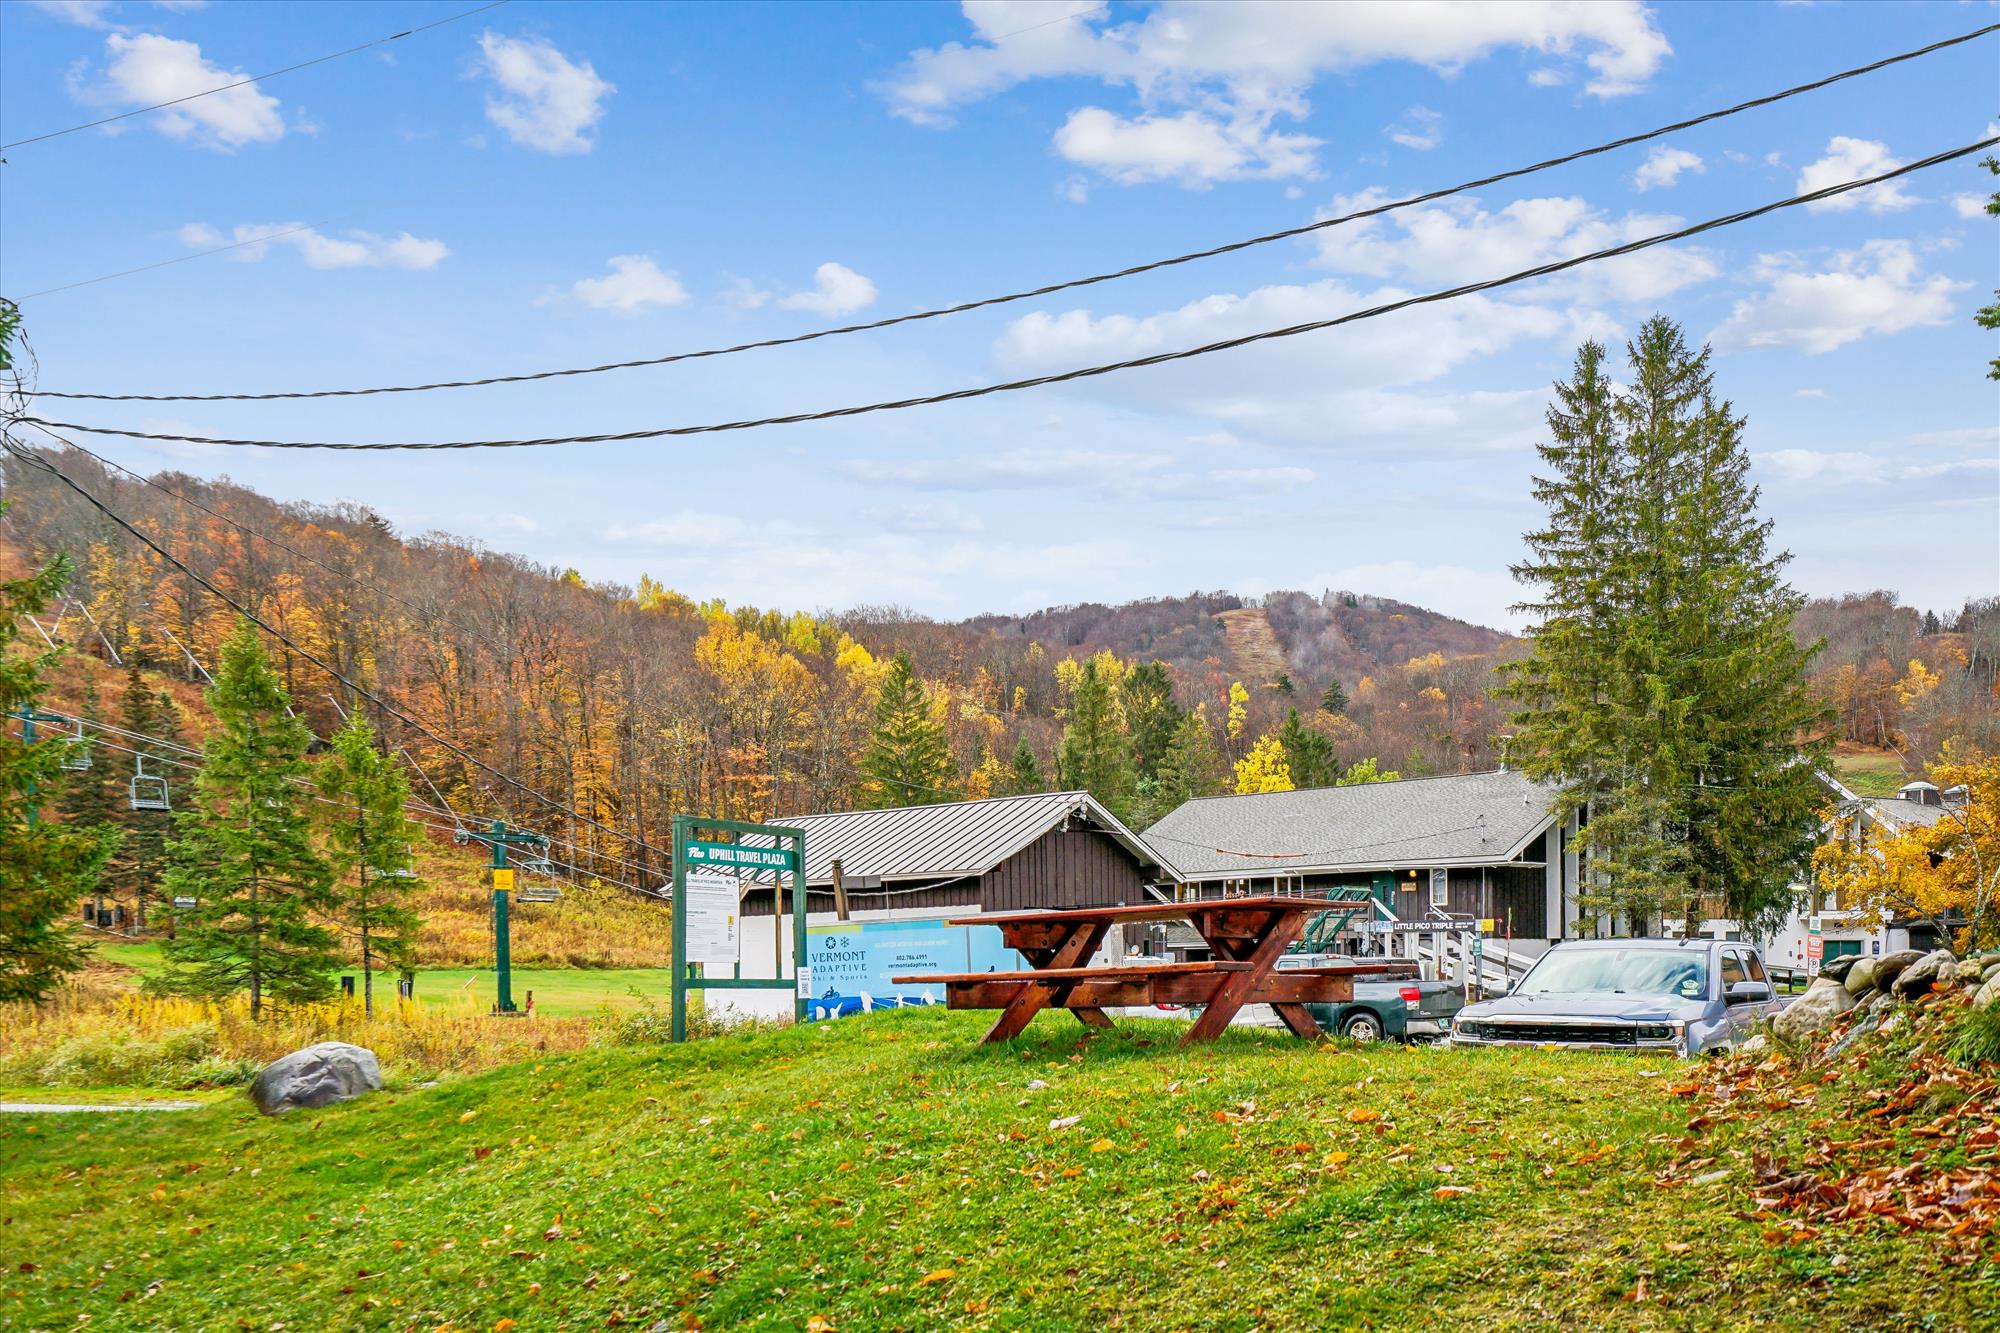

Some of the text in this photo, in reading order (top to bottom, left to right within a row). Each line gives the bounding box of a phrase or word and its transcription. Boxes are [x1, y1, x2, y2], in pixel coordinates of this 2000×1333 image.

[687, 846, 786, 866] Pico UPHILL TRAVEL PLAZA
[811, 950, 866, 963] VERMONT
[812, 963, 867, 973] ADAPTIVE
[887, 961, 937, 969] vermontadaptive.org
[840, 974, 868, 982] Sports
